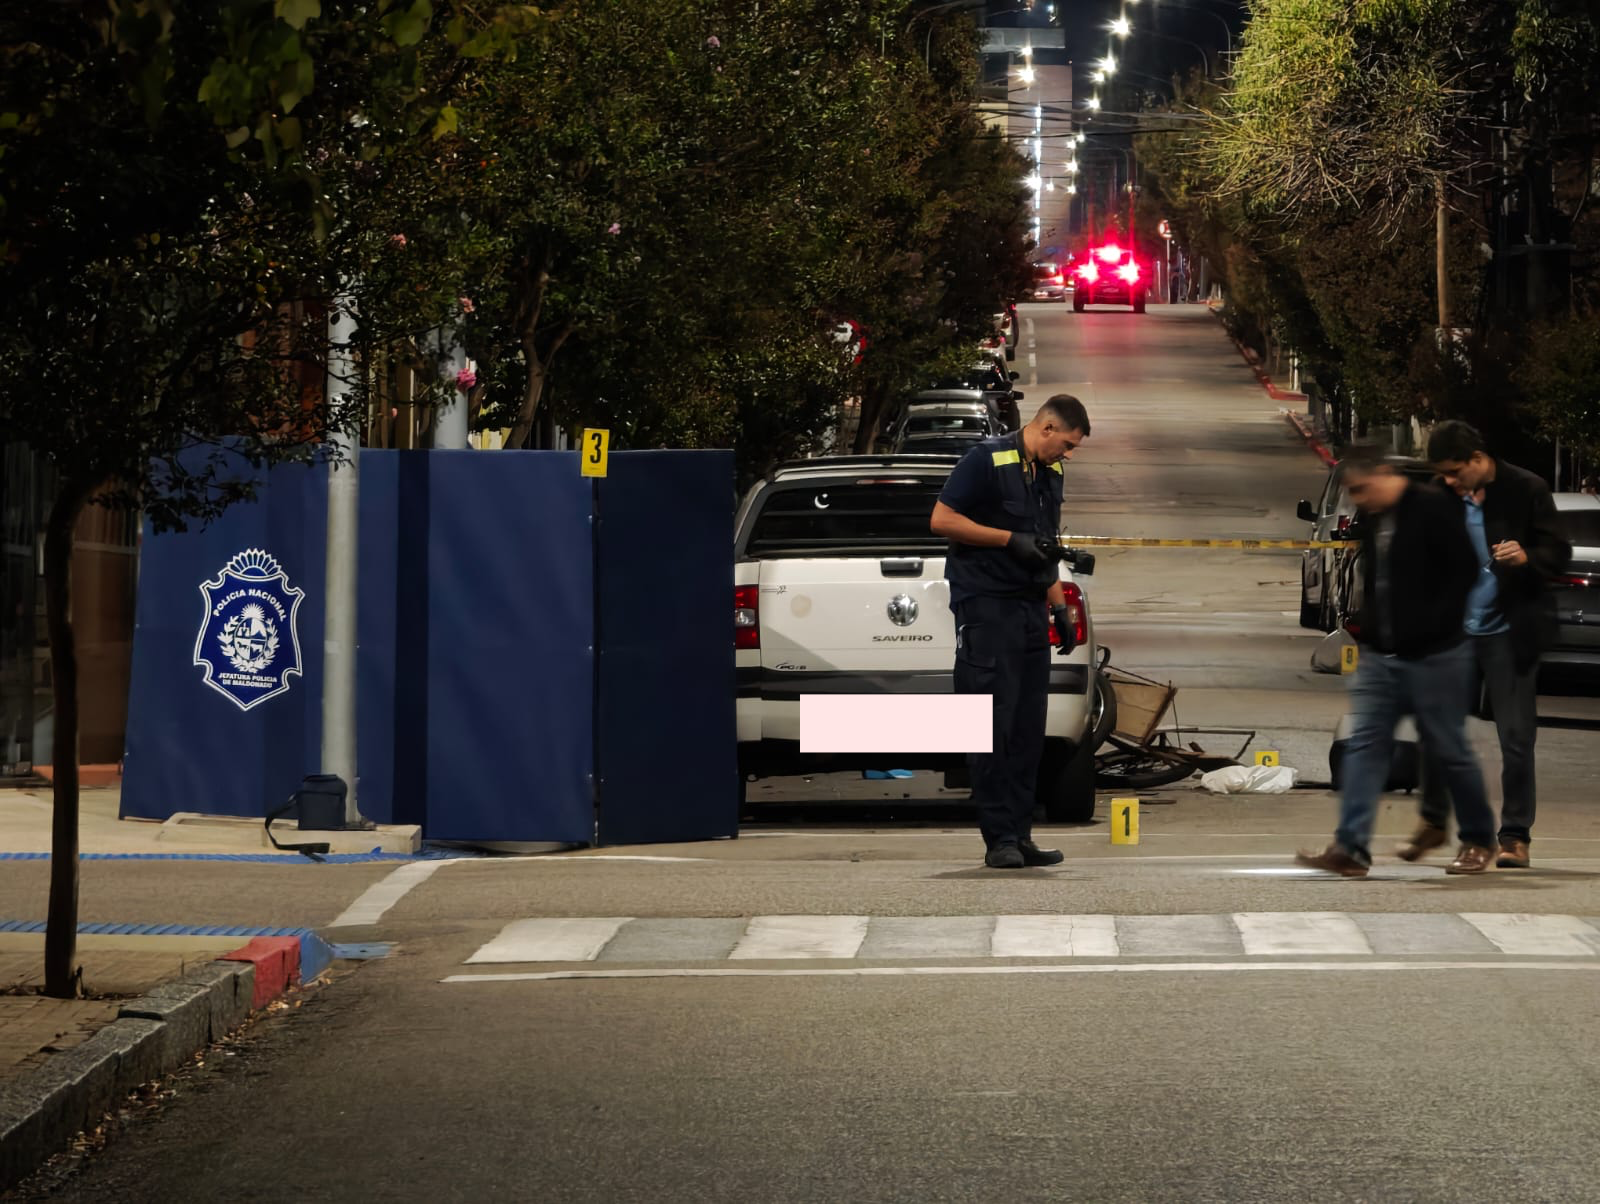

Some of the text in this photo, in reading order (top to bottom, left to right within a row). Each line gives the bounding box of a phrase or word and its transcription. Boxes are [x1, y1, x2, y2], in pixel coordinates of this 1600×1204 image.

[590, 432, 602, 464] 3
[213, 588, 287, 622] POLICIA NACIONAL
[1122, 806, 1130, 837] 1
